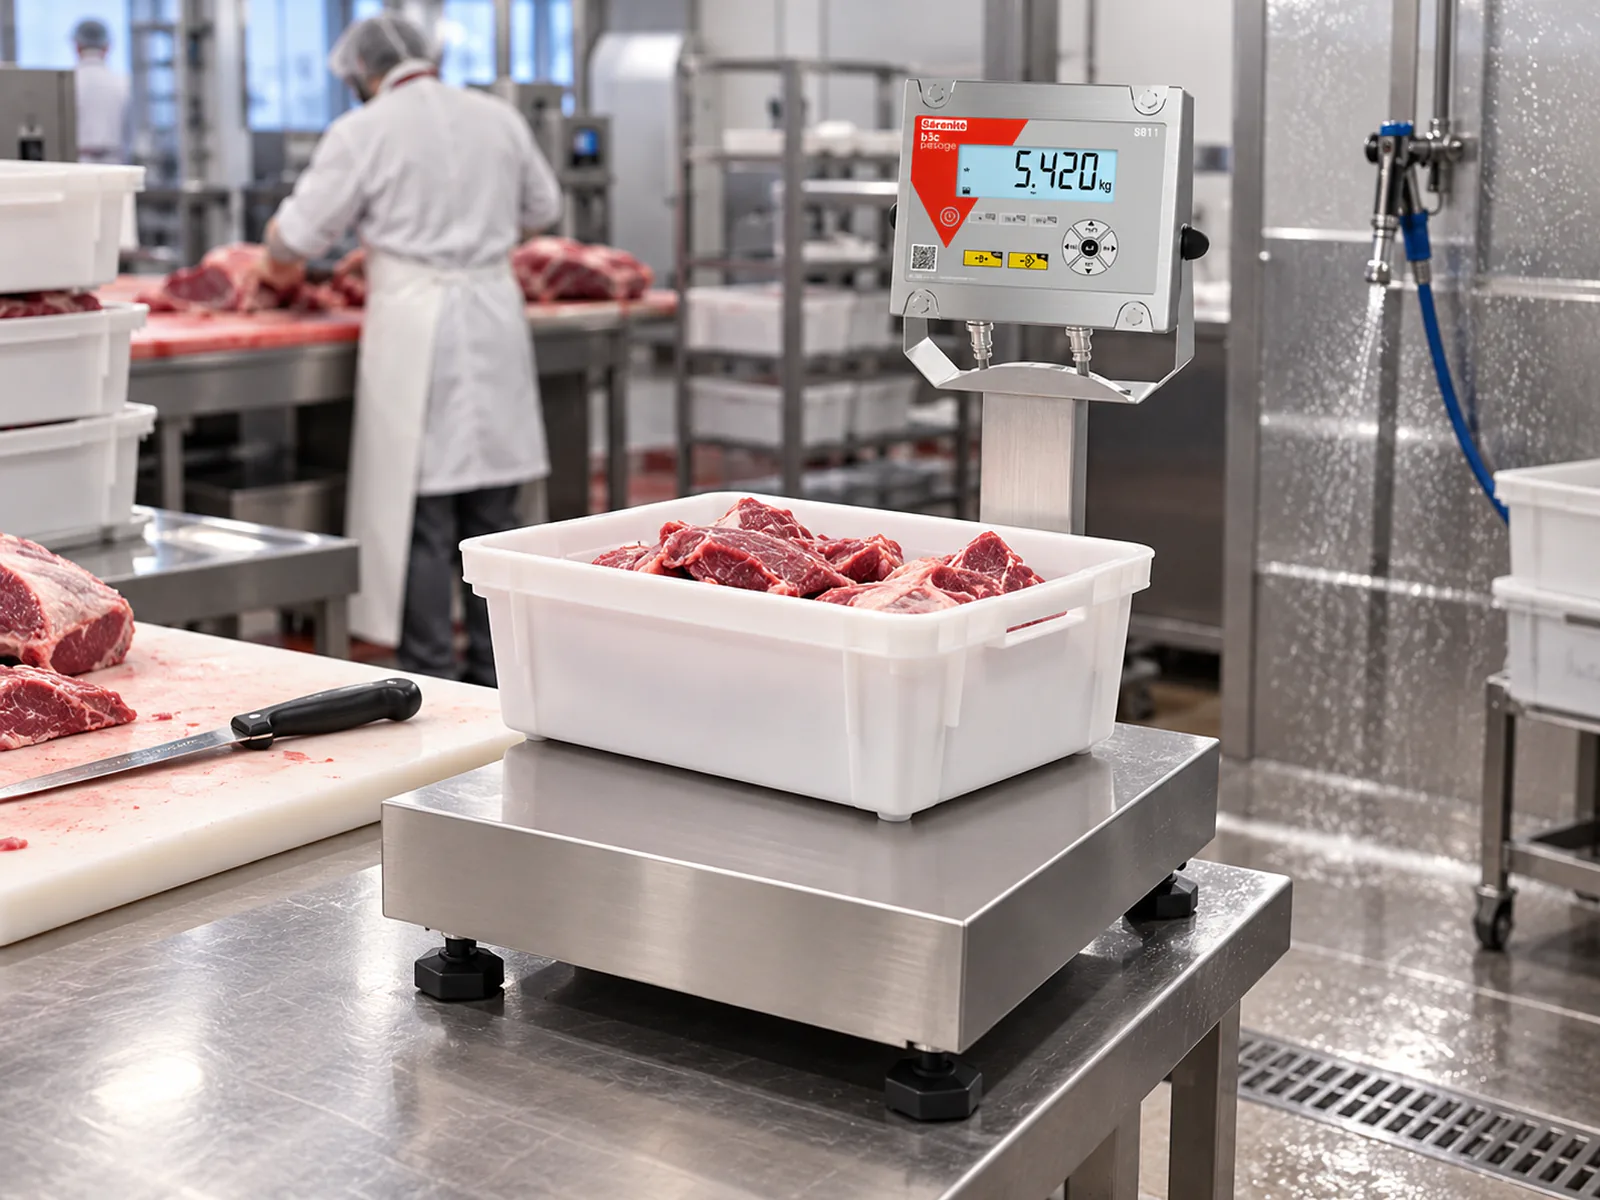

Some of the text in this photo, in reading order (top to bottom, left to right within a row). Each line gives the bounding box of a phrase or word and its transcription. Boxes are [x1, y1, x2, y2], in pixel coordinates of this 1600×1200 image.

[1134, 127, 1158, 137] S811
[1014, 150, 1112, 193] 5.420 kg
